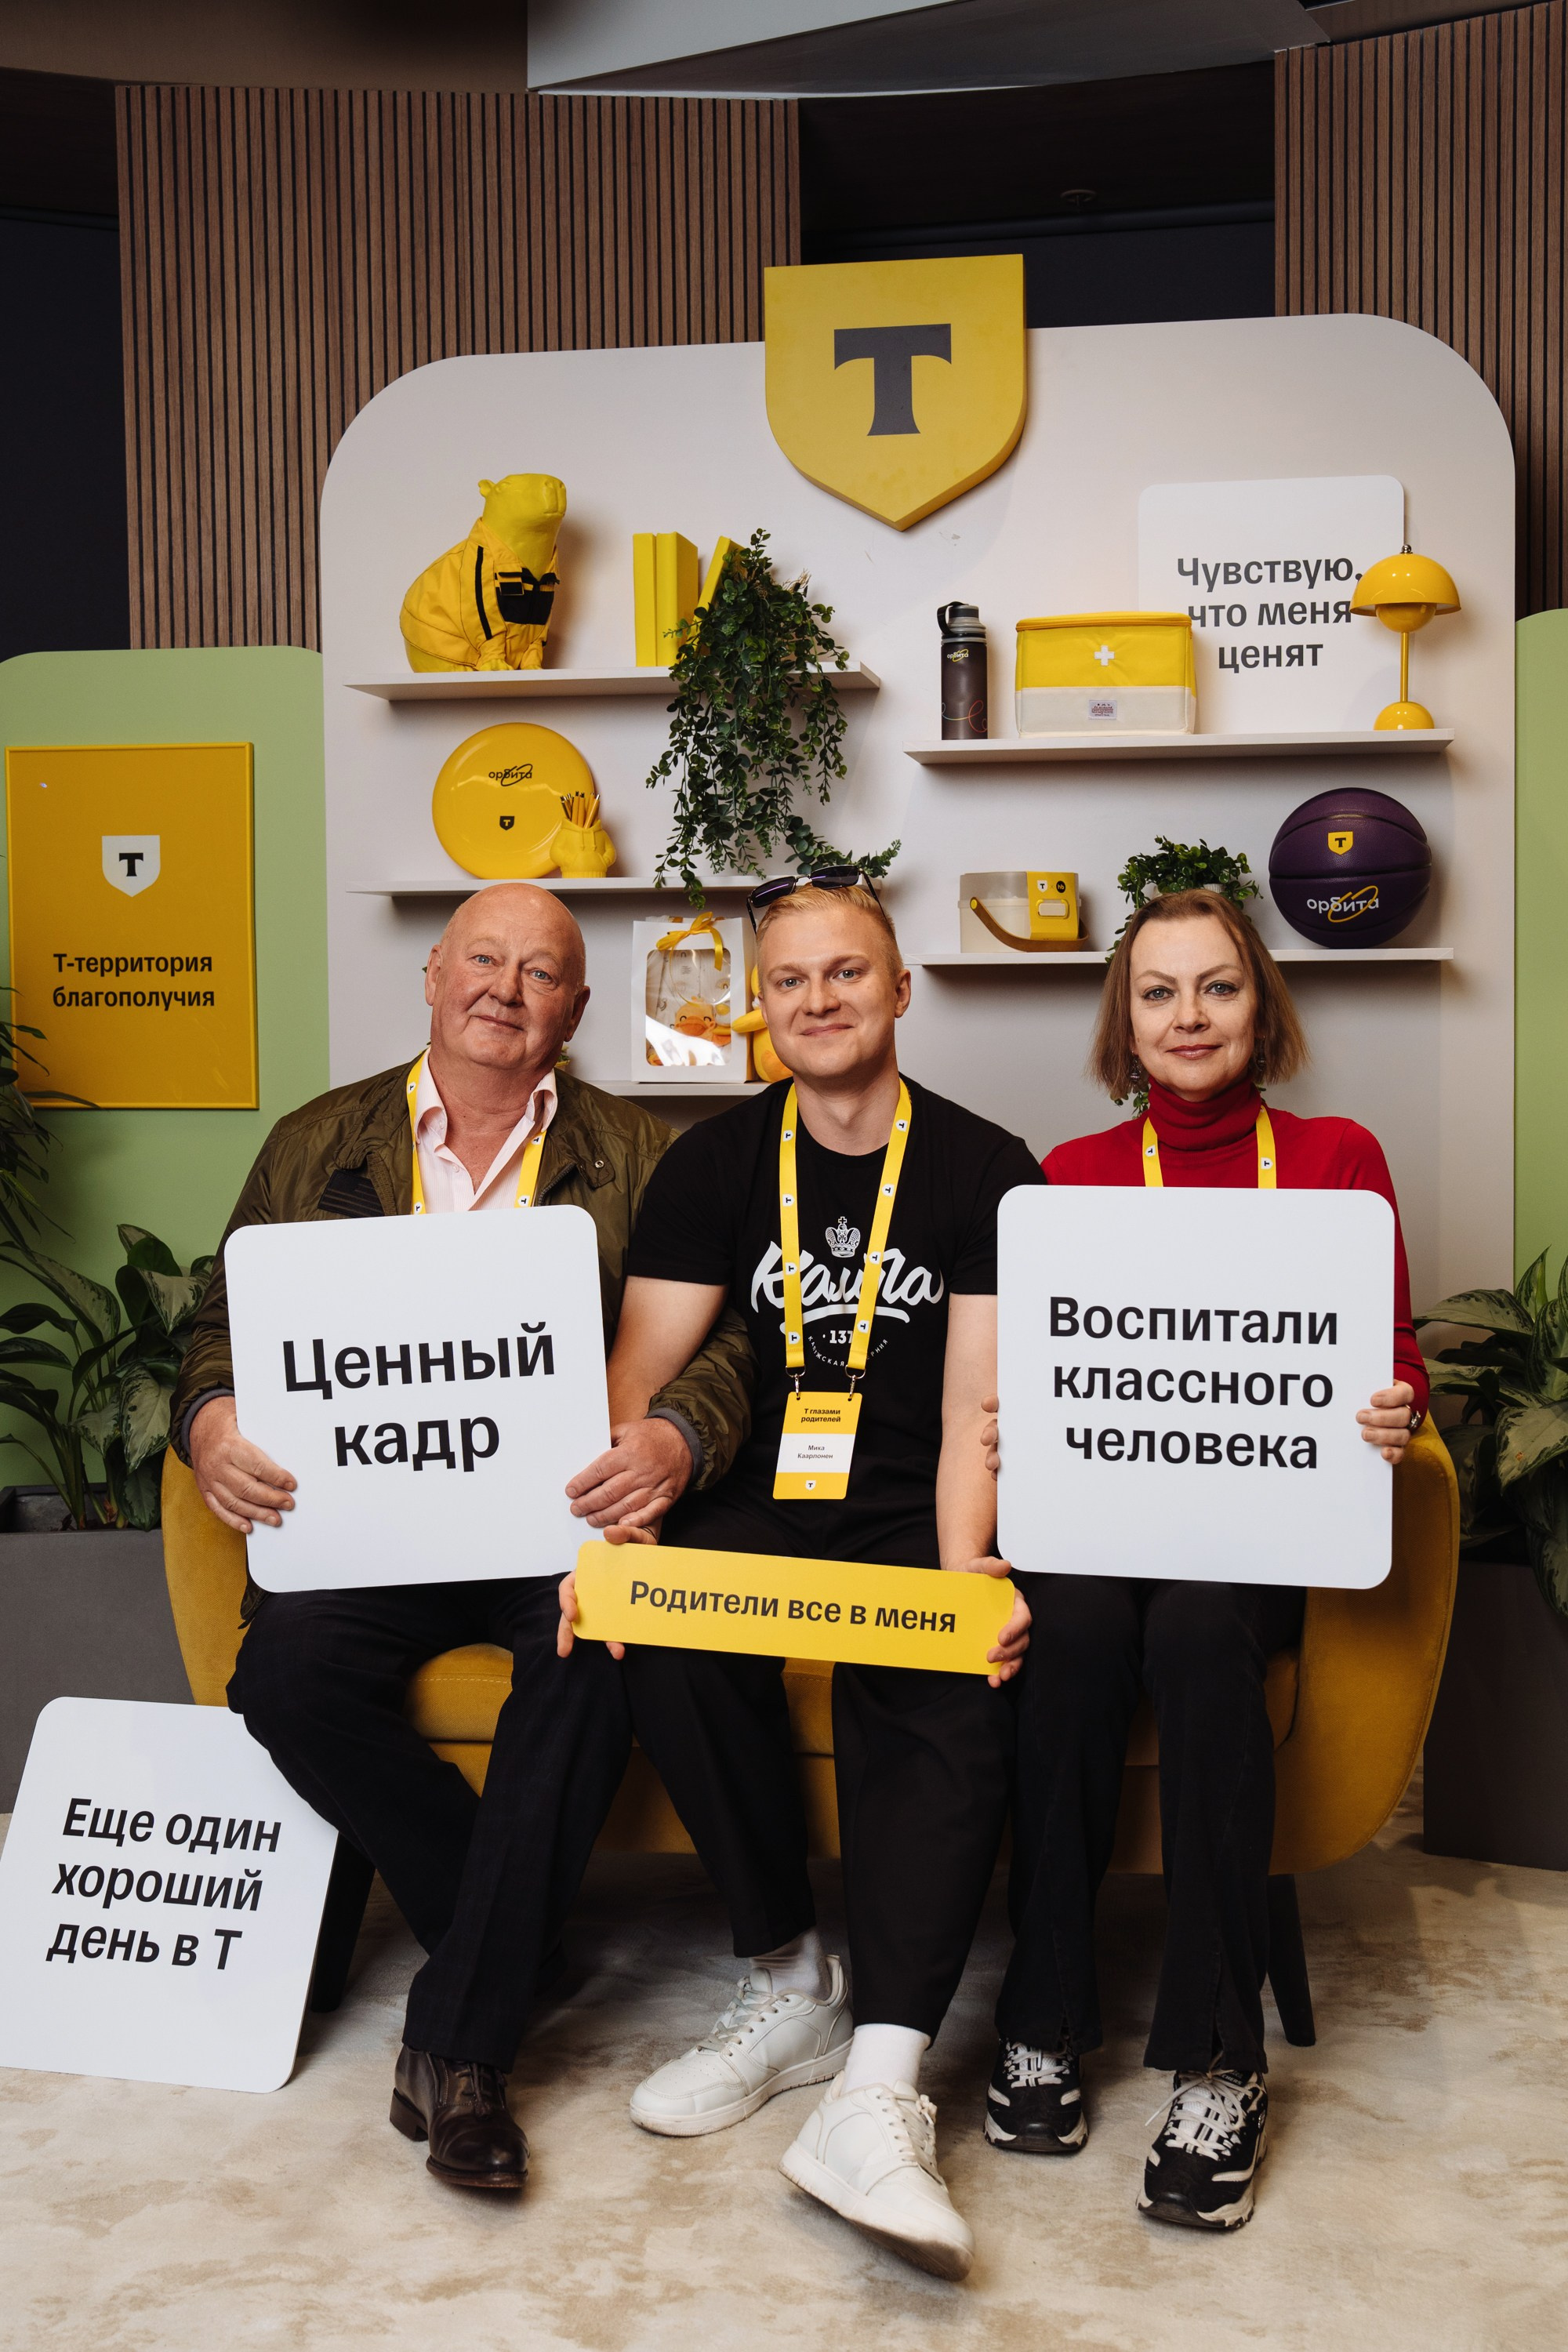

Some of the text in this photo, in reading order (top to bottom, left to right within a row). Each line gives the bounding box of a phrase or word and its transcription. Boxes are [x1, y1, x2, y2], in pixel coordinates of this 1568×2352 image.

[1188, 600, 1352, 627] что меня
[946, 651, 969, 660] орбита
[1218, 644, 1324, 673] ценят
[488, 767, 532, 782] орбита
[1306, 894, 1379, 916] орбита
[53, 953, 212, 977] Т-территория
[53, 985, 215, 1011] благополучия
[829, 1330, 854, 1344] 137
[1050, 1296, 1338, 1345] Воспитали
[283, 1321, 555, 1400] Ценный
[1054, 1366, 1334, 1407] классного
[334, 1414, 500, 1472] кадр
[1066, 1427, 1317, 1469] человека
[630, 1580, 956, 1633] Родители все в меня
[62, 1798, 281, 1855] Еще один
[52, 1863, 263, 1911] хороший
[45, 1923, 243, 1970] день в Т
